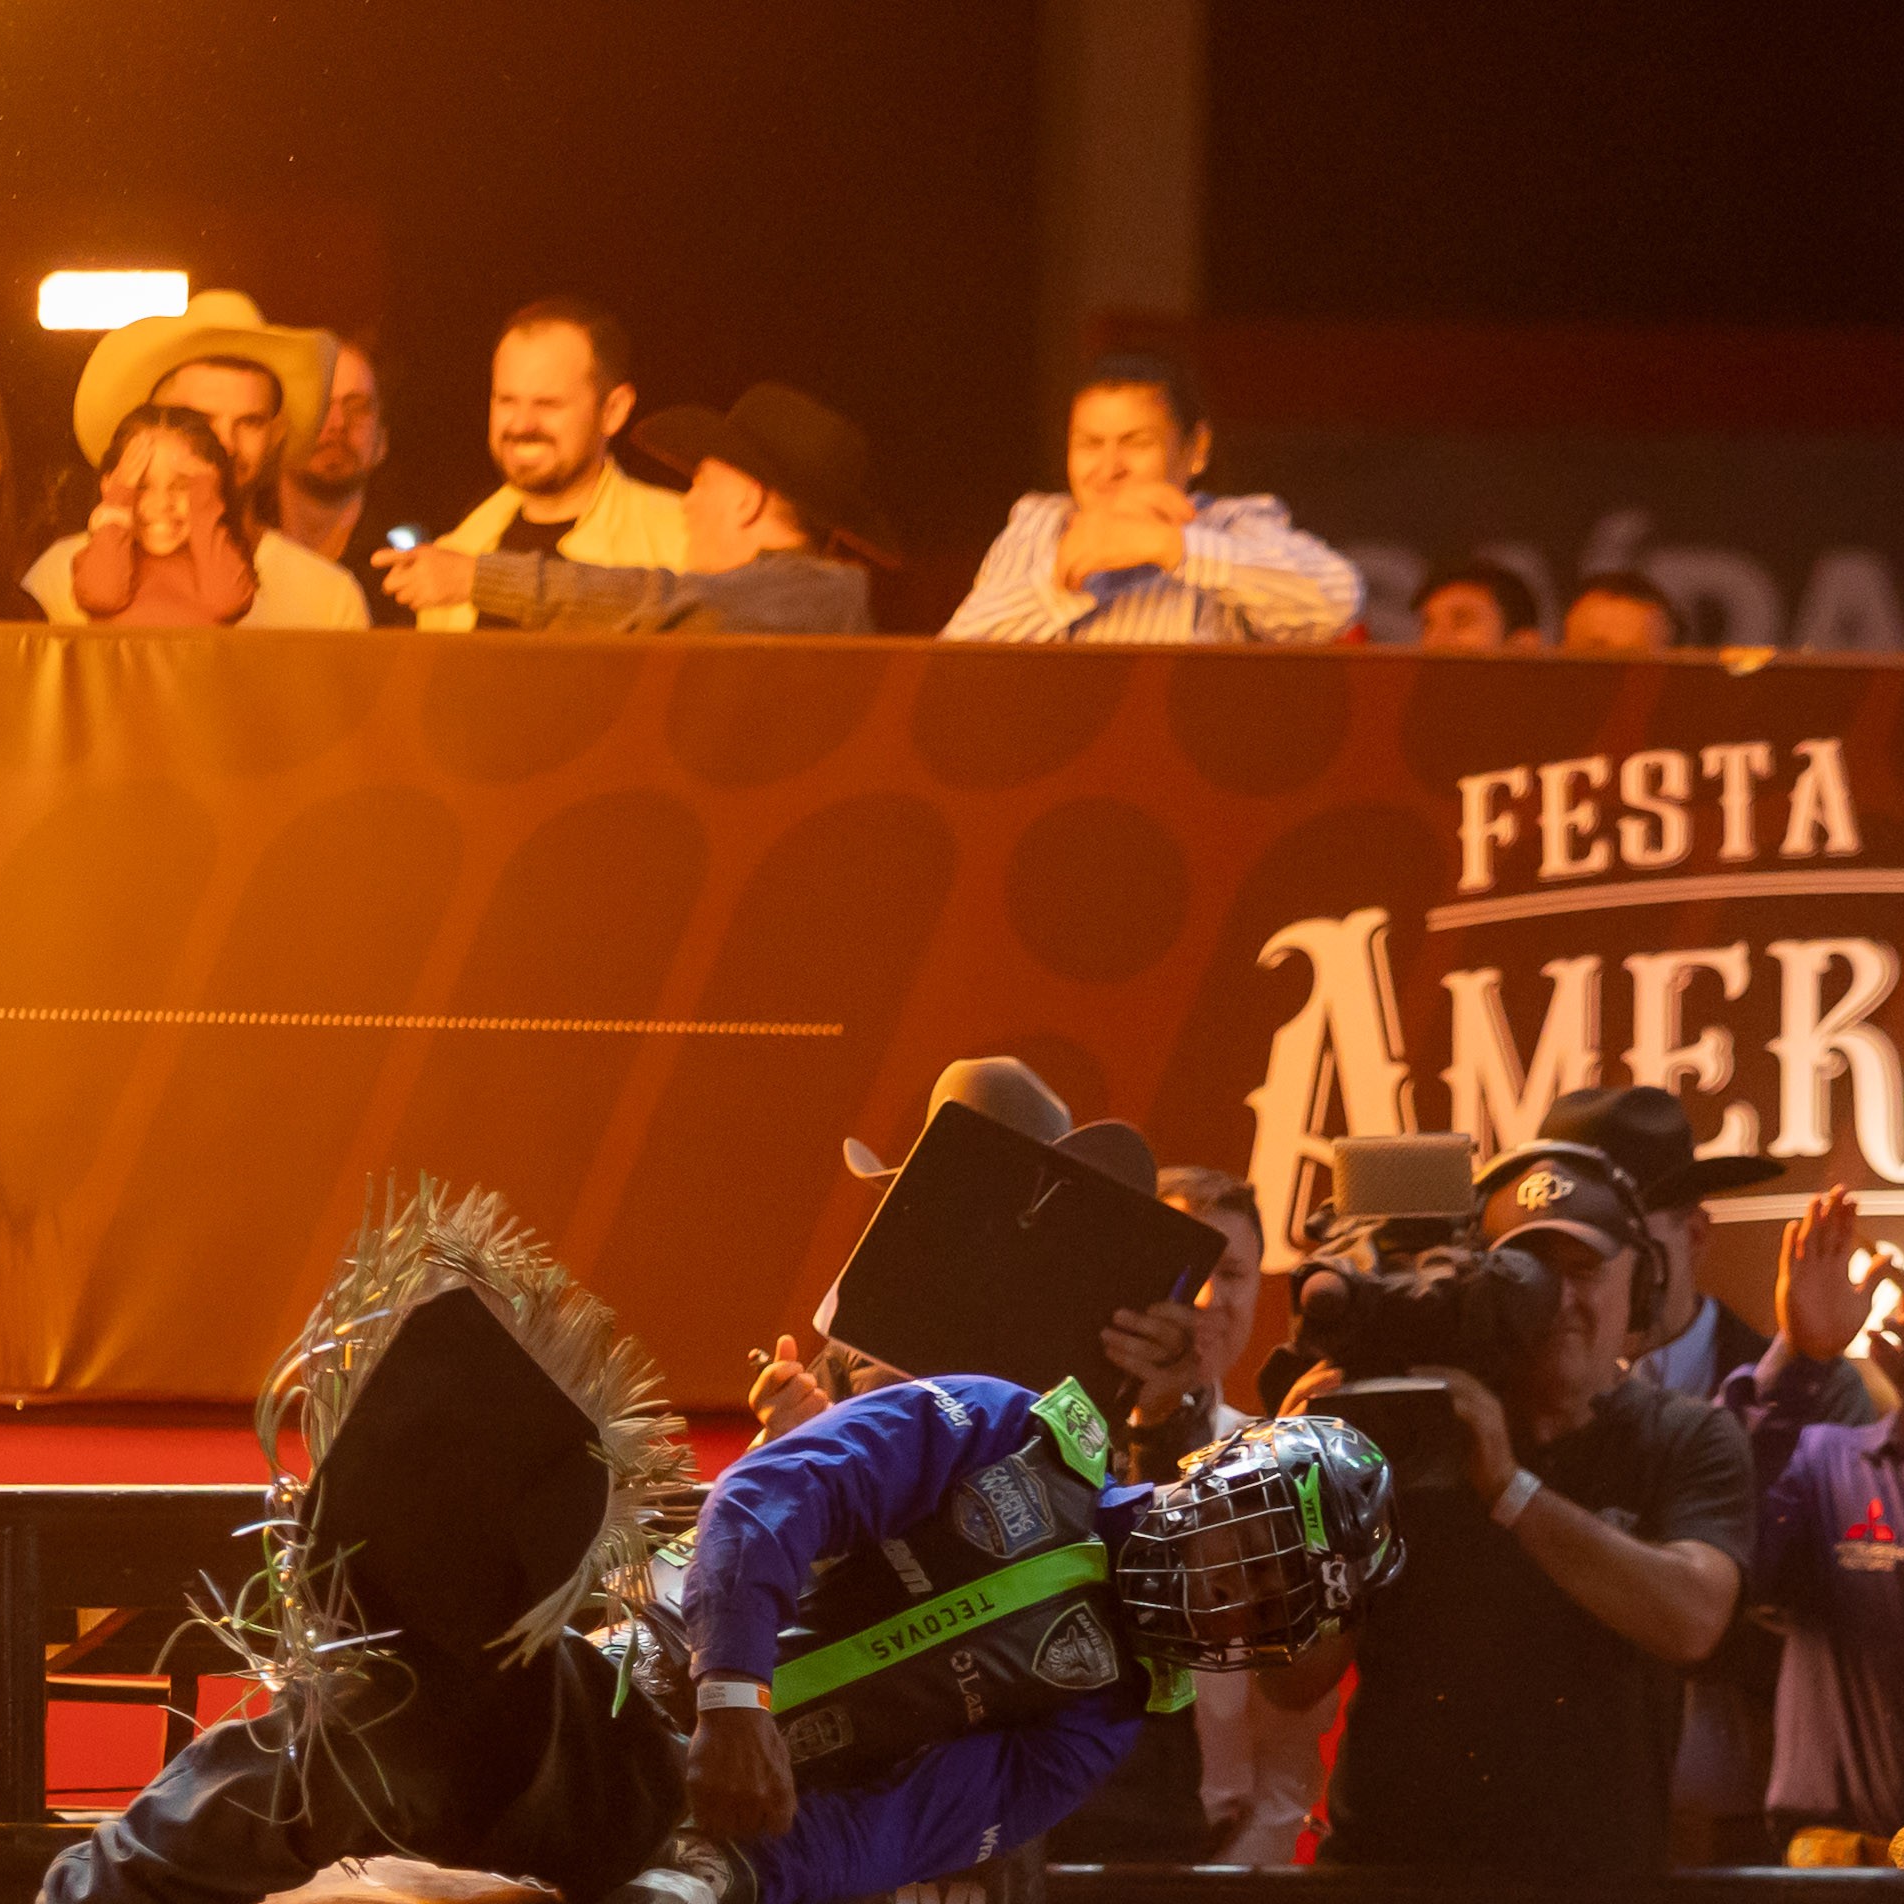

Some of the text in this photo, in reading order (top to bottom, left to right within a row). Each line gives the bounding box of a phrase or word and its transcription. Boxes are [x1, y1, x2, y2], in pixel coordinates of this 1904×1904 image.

[1456, 737, 1861, 895] FESTA
[978, 1472, 1026, 1540] WORLD
[990, 1465, 1035, 1531] CAMPING
[1303, 1496, 1320, 1530] YETI
[869, 1591, 997, 1662] TECOVAS
